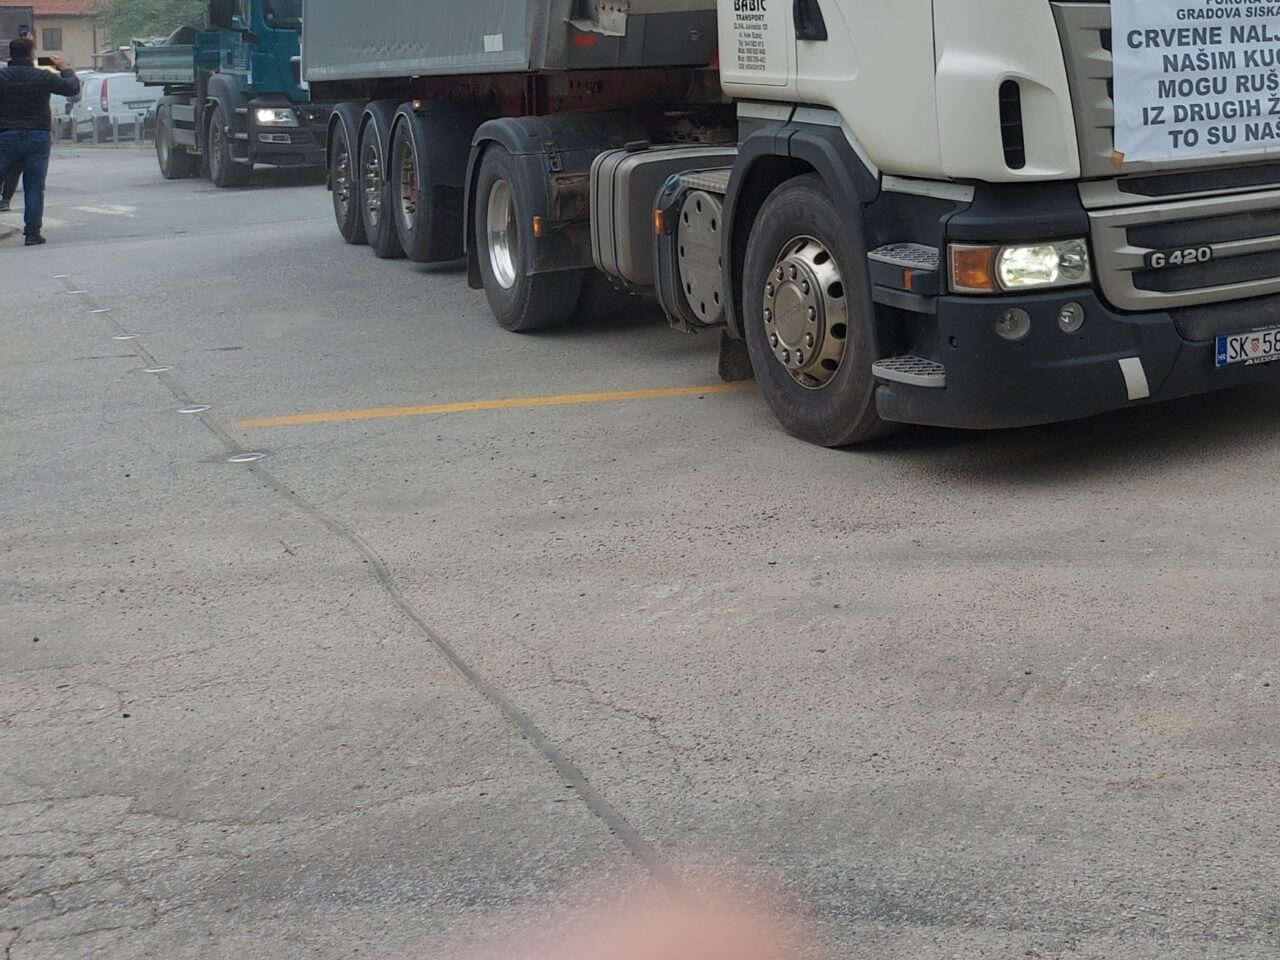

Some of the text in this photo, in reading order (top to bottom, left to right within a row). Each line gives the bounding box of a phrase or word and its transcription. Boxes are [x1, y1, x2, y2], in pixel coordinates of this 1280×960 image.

[735, 13, 765, 22] TRANSPORT
[1176, 6, 1242, 21] GRADOVA
[1126, 26, 1222, 49] CRVENE
[1162, 48, 1237, 73] NAŠIM
[1158, 76, 1228, 98] MOGU
[1142, 106, 1166, 125] IZ
[1173, 99, 1261, 123] DRUGIH
[1168, 128, 1199, 149] TO
[1207, 125, 1236, 145] SU
[1150, 246, 1212, 268] G 420
[1229, 336, 1249, 360] SK
